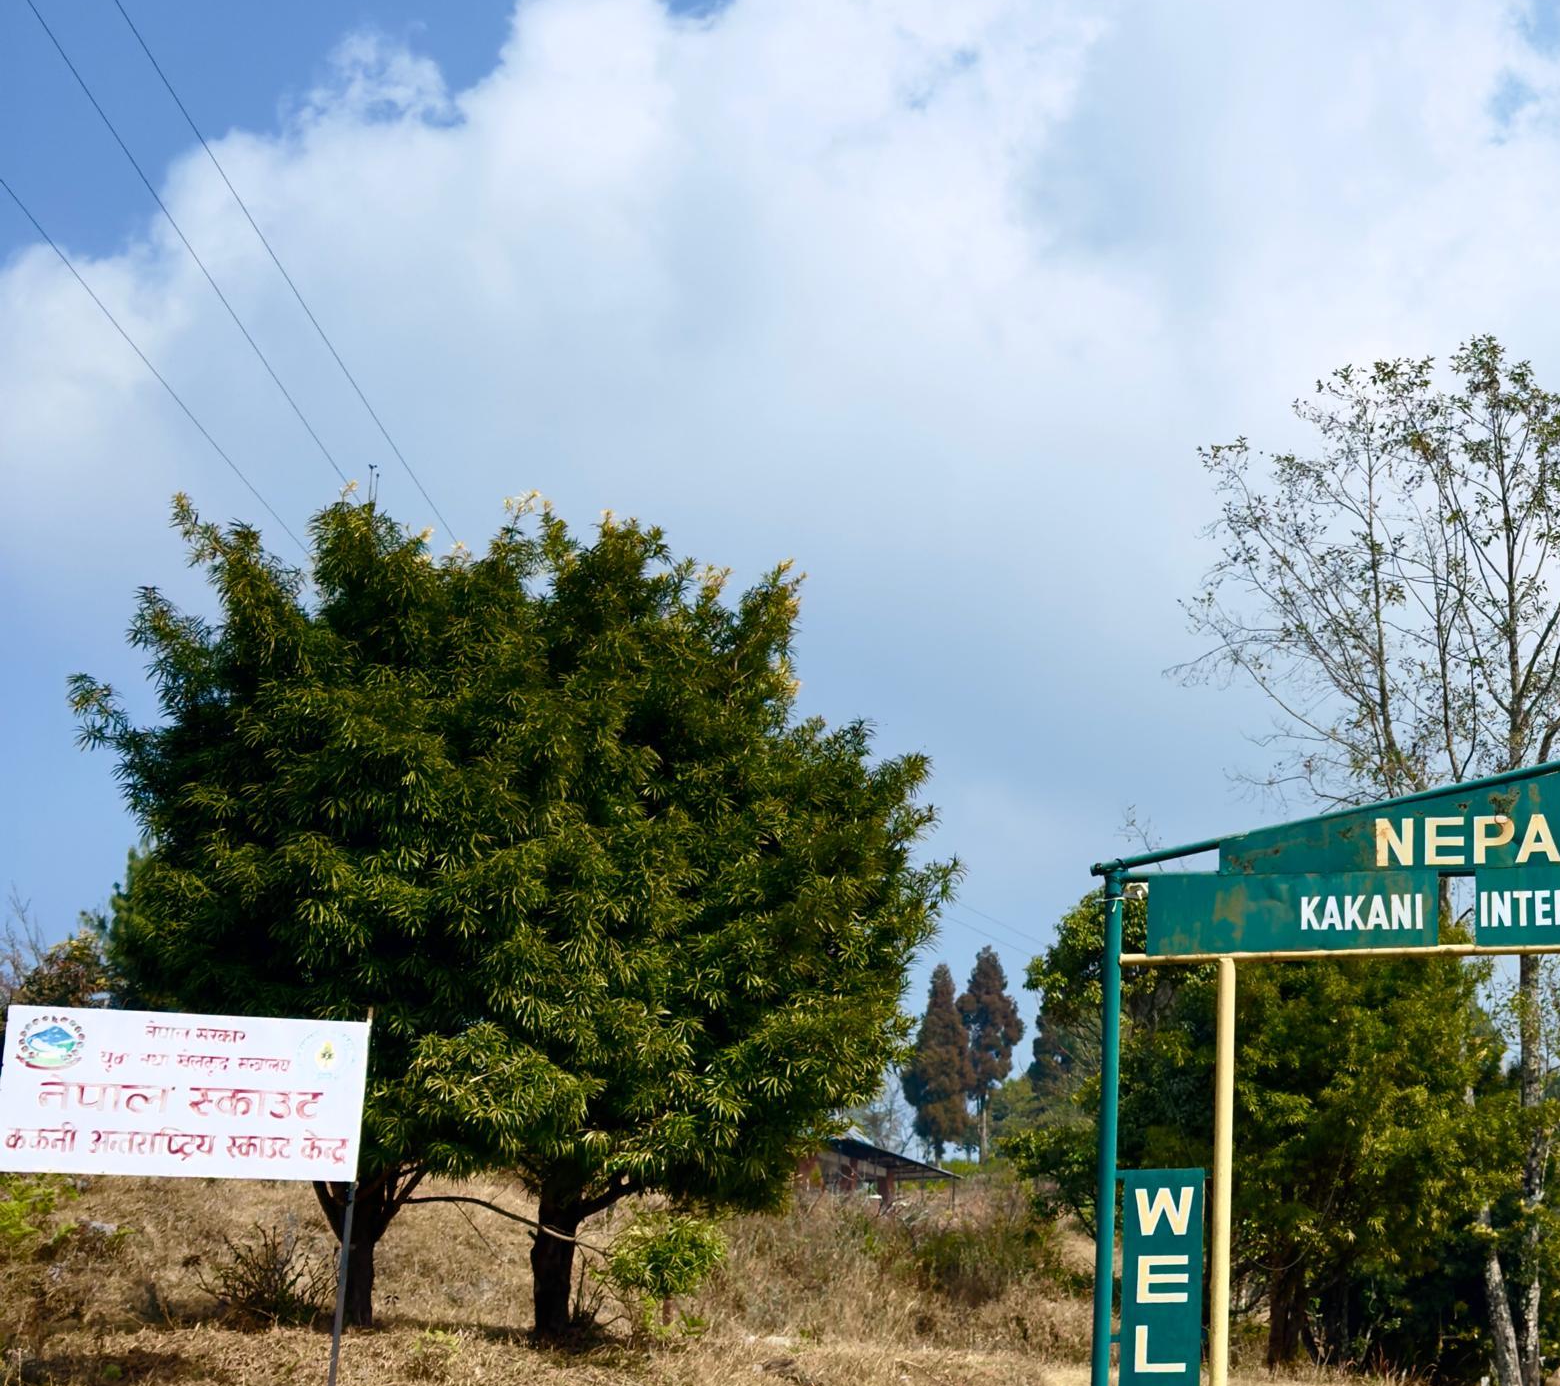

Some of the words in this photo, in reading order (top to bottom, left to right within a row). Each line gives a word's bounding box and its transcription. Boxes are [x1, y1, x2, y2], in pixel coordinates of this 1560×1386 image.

[1300, 893, 1424, 931] KAKANI
[38, 1074, 172, 1114] नेपाल
[189, 1086, 324, 1120] स्काउट
[226, 1134, 292, 1159] स्काउट
